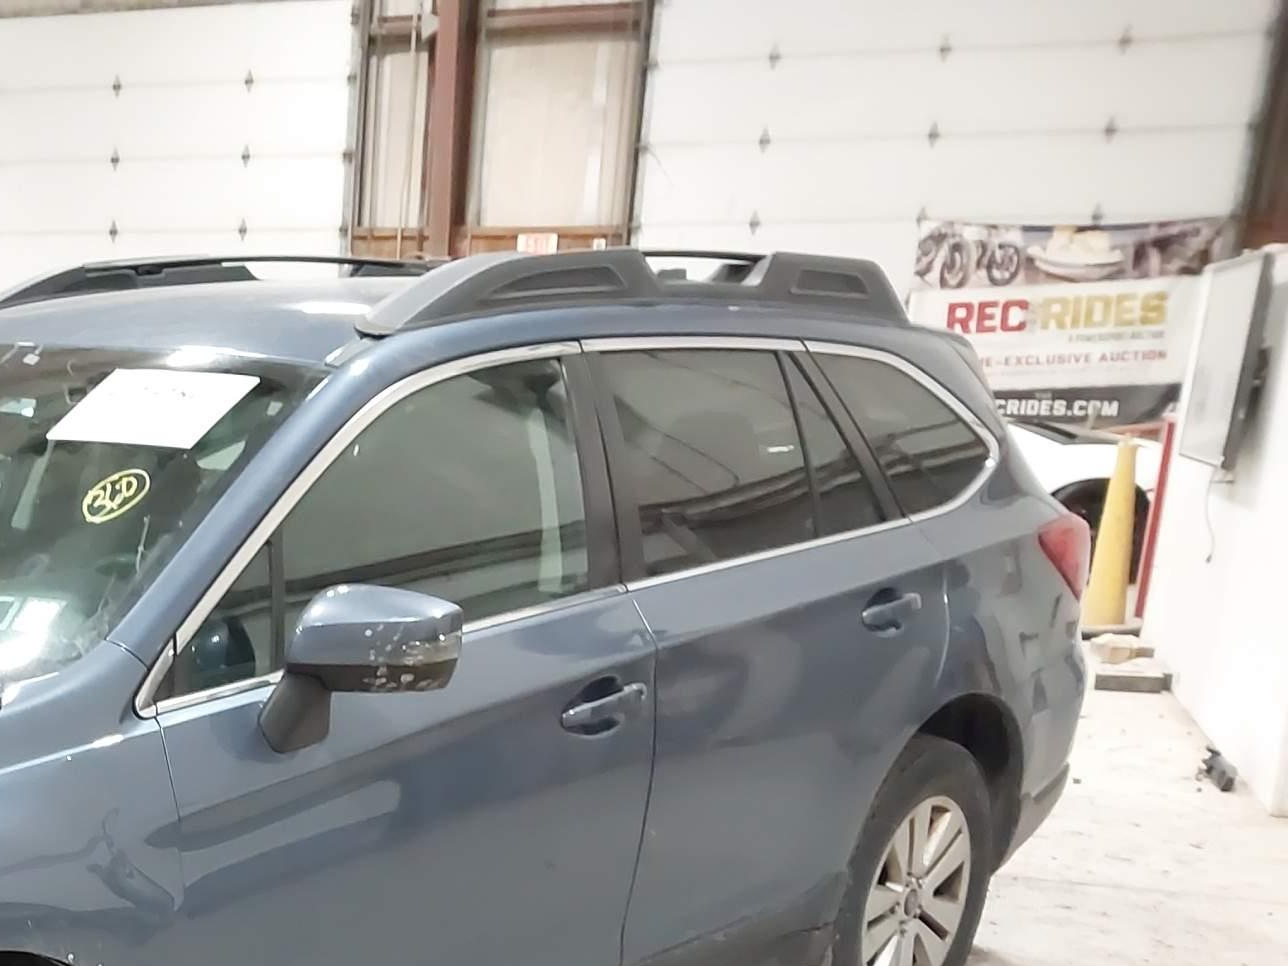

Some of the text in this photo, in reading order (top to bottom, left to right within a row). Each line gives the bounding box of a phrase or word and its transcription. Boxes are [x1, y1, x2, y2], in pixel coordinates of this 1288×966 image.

[946, 292, 1169, 334] REC RIDES
[1098, 350, 1168, 363] AUCTION
